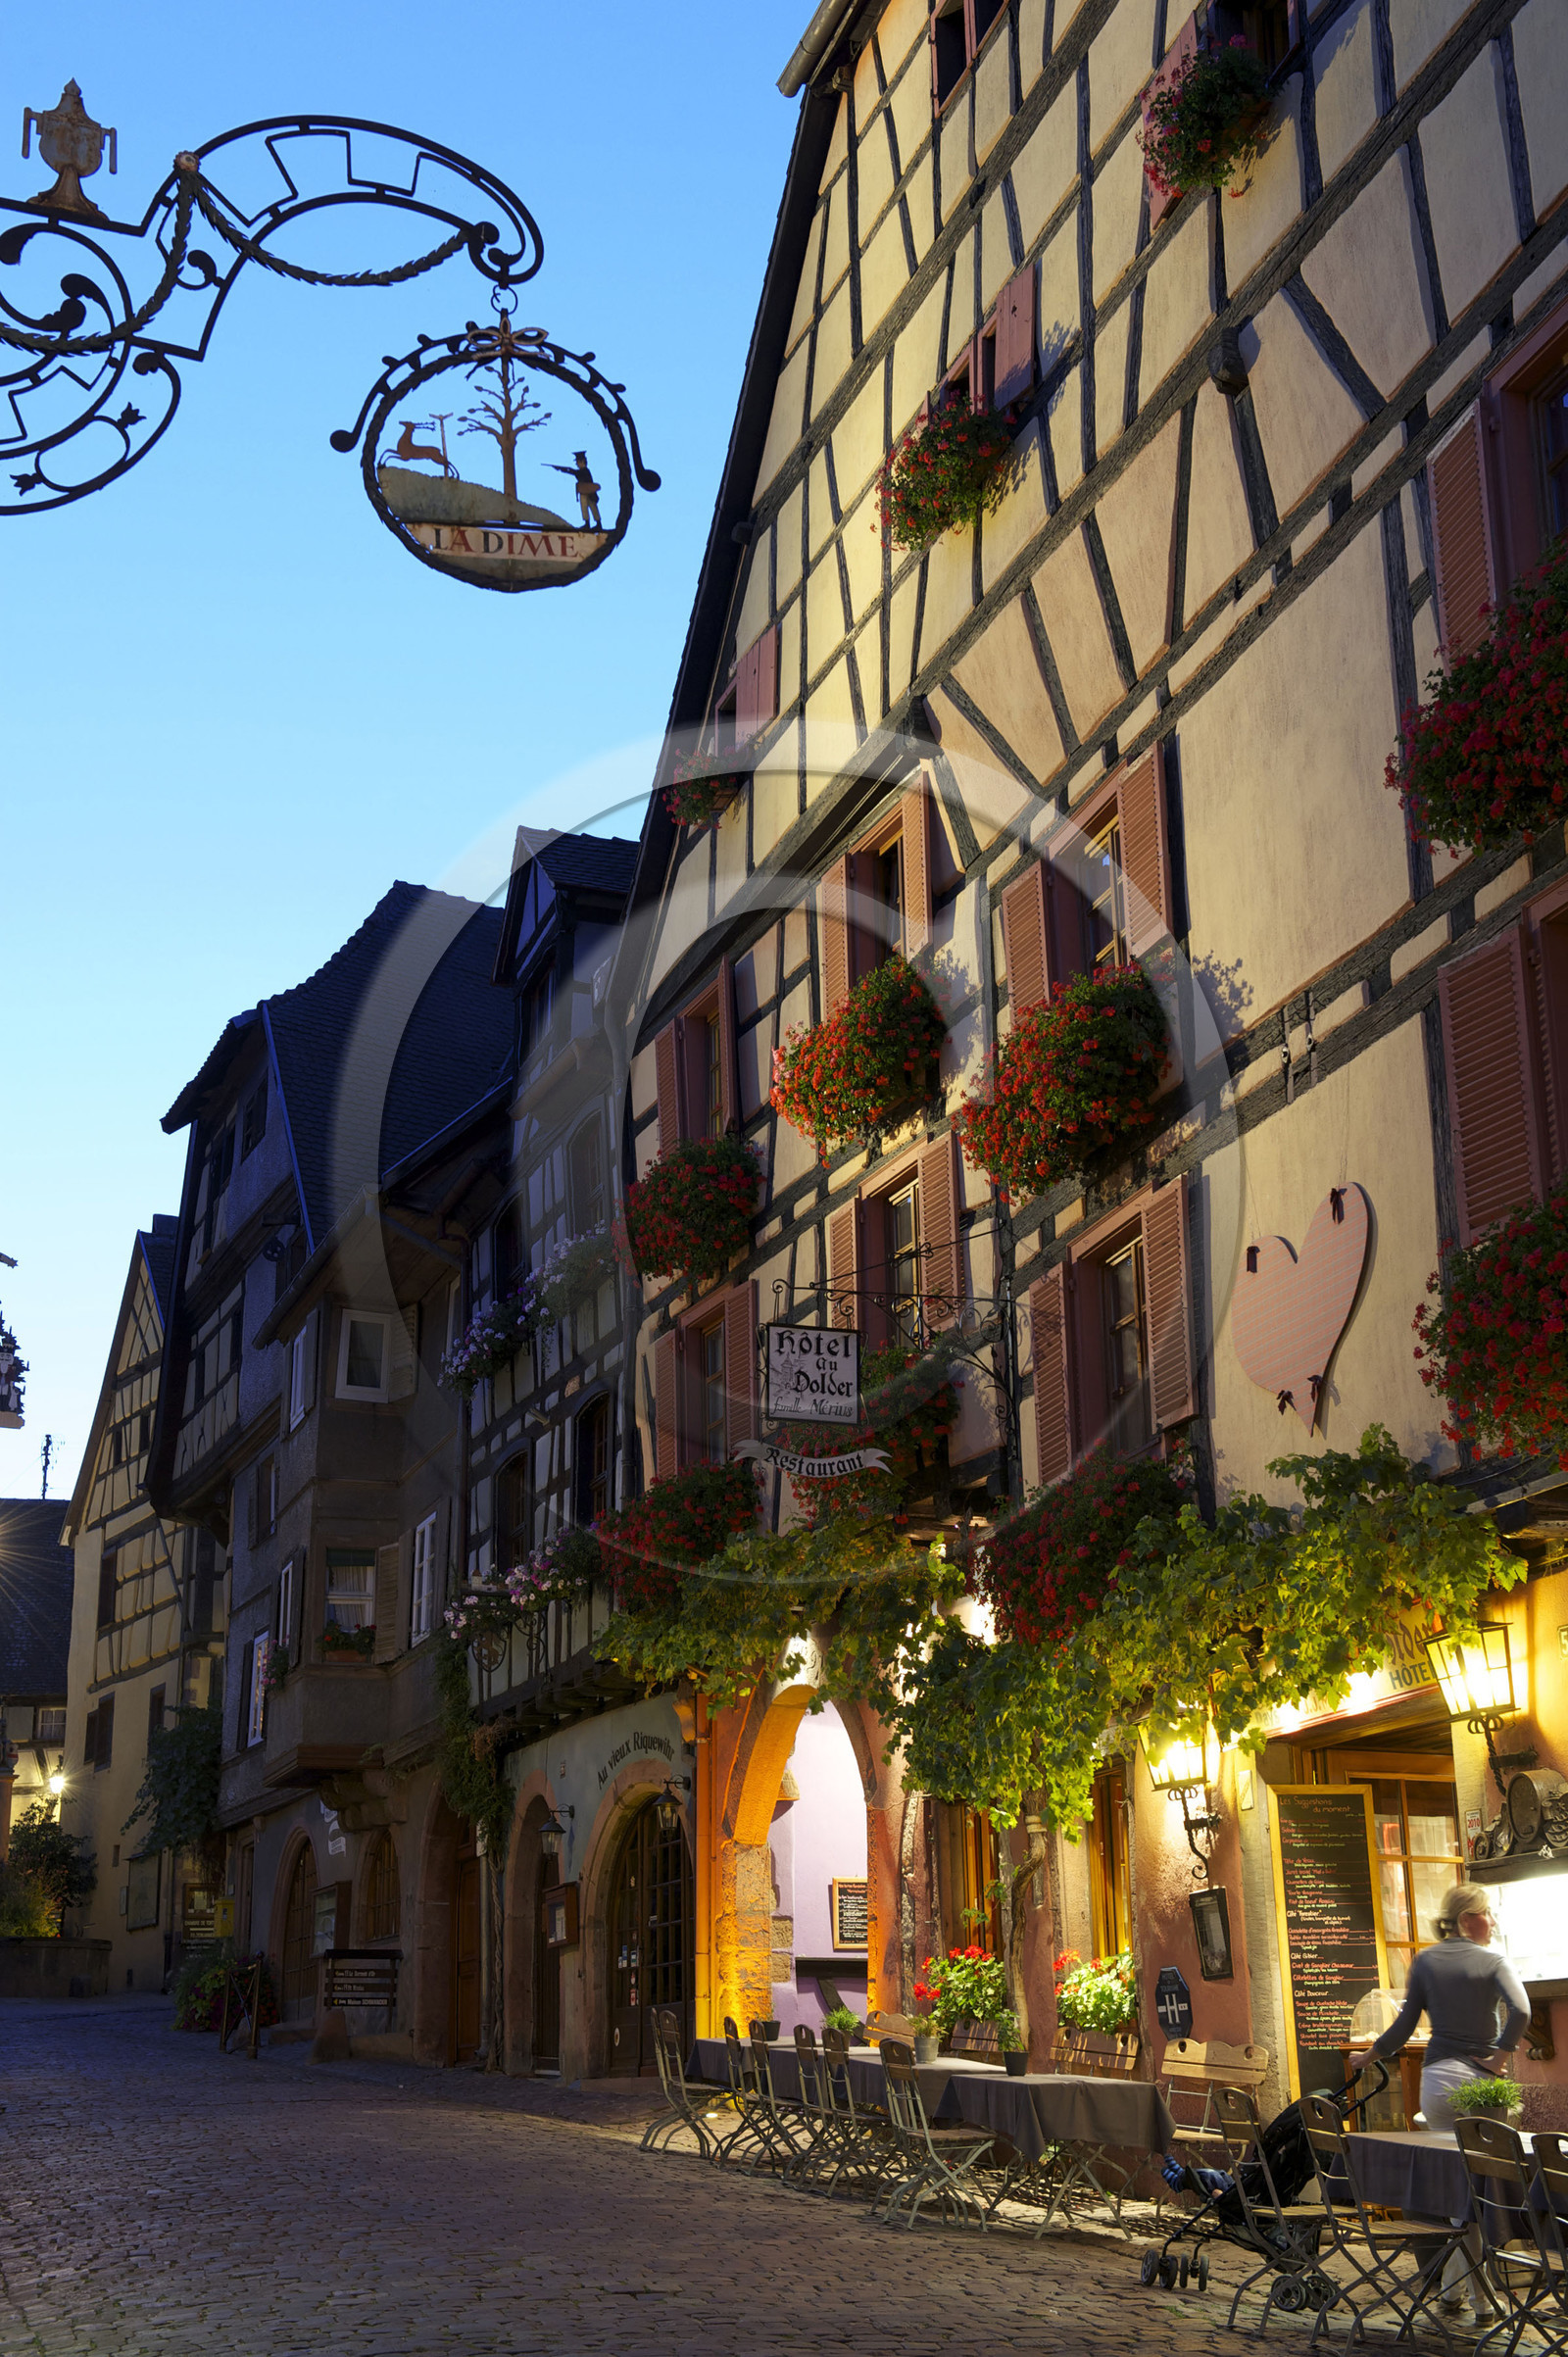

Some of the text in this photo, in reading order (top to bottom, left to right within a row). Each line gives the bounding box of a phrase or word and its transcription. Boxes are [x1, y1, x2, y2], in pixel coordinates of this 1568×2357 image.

[434, 528, 578, 558] LA DIME
[775, 1330, 852, 1357] Hôtel
[791, 1370, 853, 1397] Dolder
[764, 1448, 864, 1477] Restaurant
[598, 1732, 674, 1790] Au vieux Riquewihr
[1468, 1818, 1480, 1828] 2010
[1164, 1992, 1181, 2025] H
